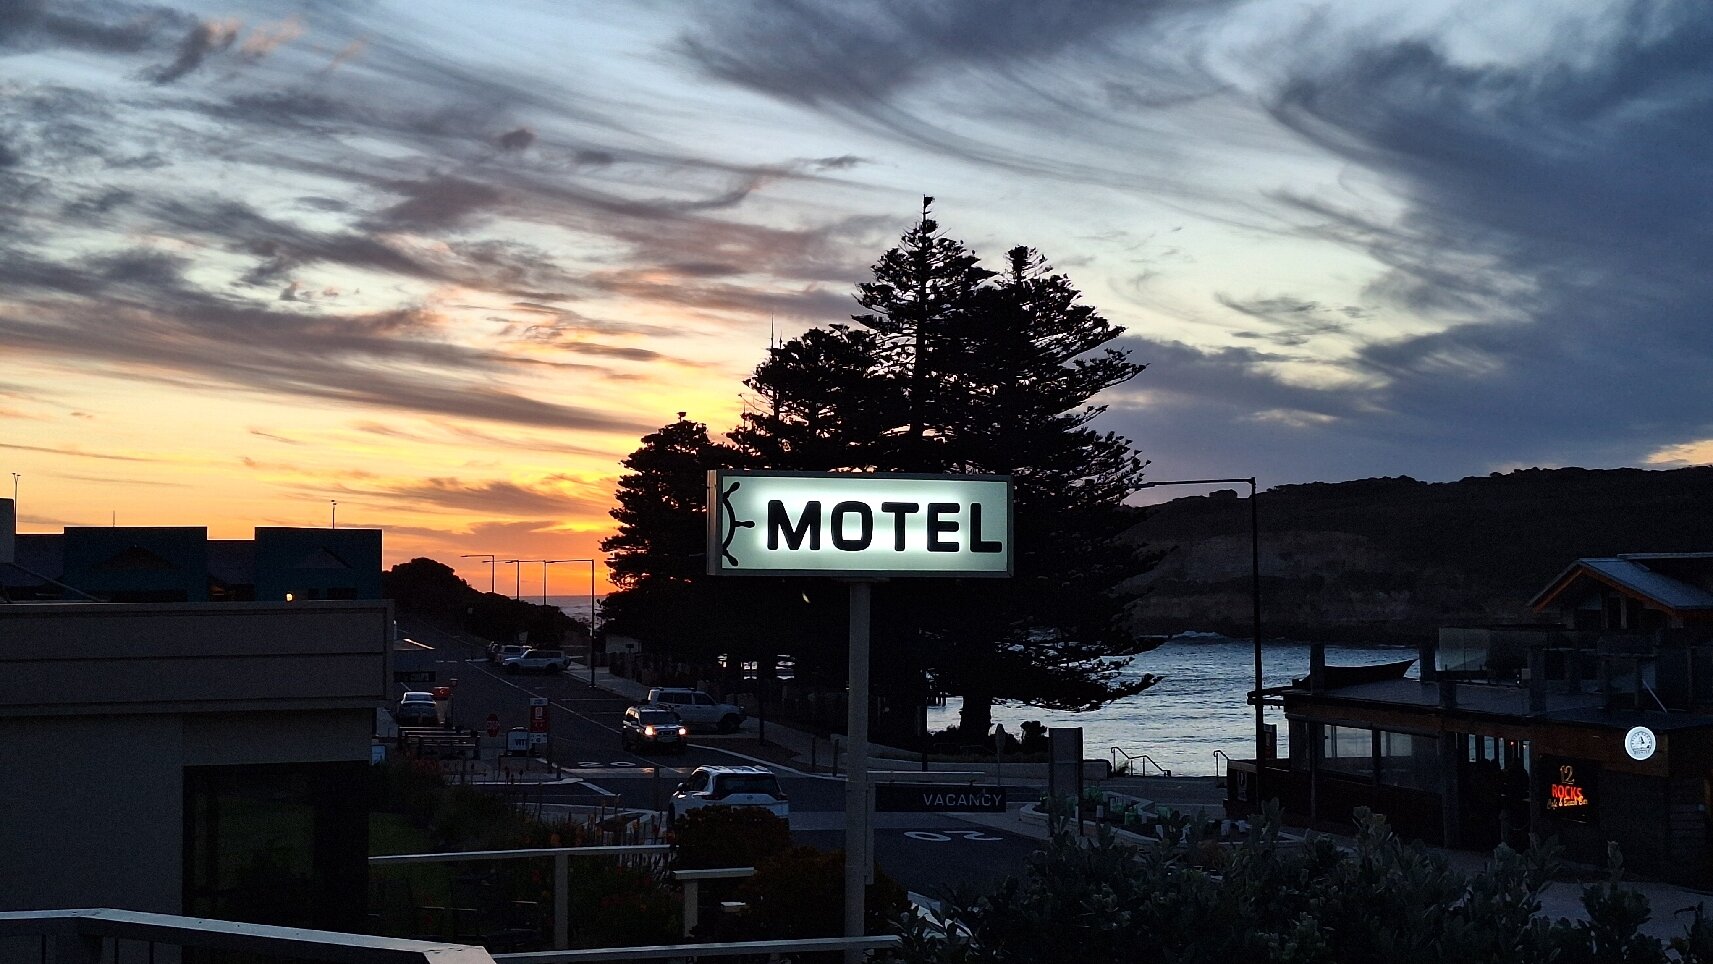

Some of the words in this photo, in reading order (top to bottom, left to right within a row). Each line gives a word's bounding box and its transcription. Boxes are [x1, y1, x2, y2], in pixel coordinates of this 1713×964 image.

[767, 500, 1002, 553] MOTEL
[1552, 784, 1582, 799] ROCKS
[923, 793, 1002, 807] VACANCY
